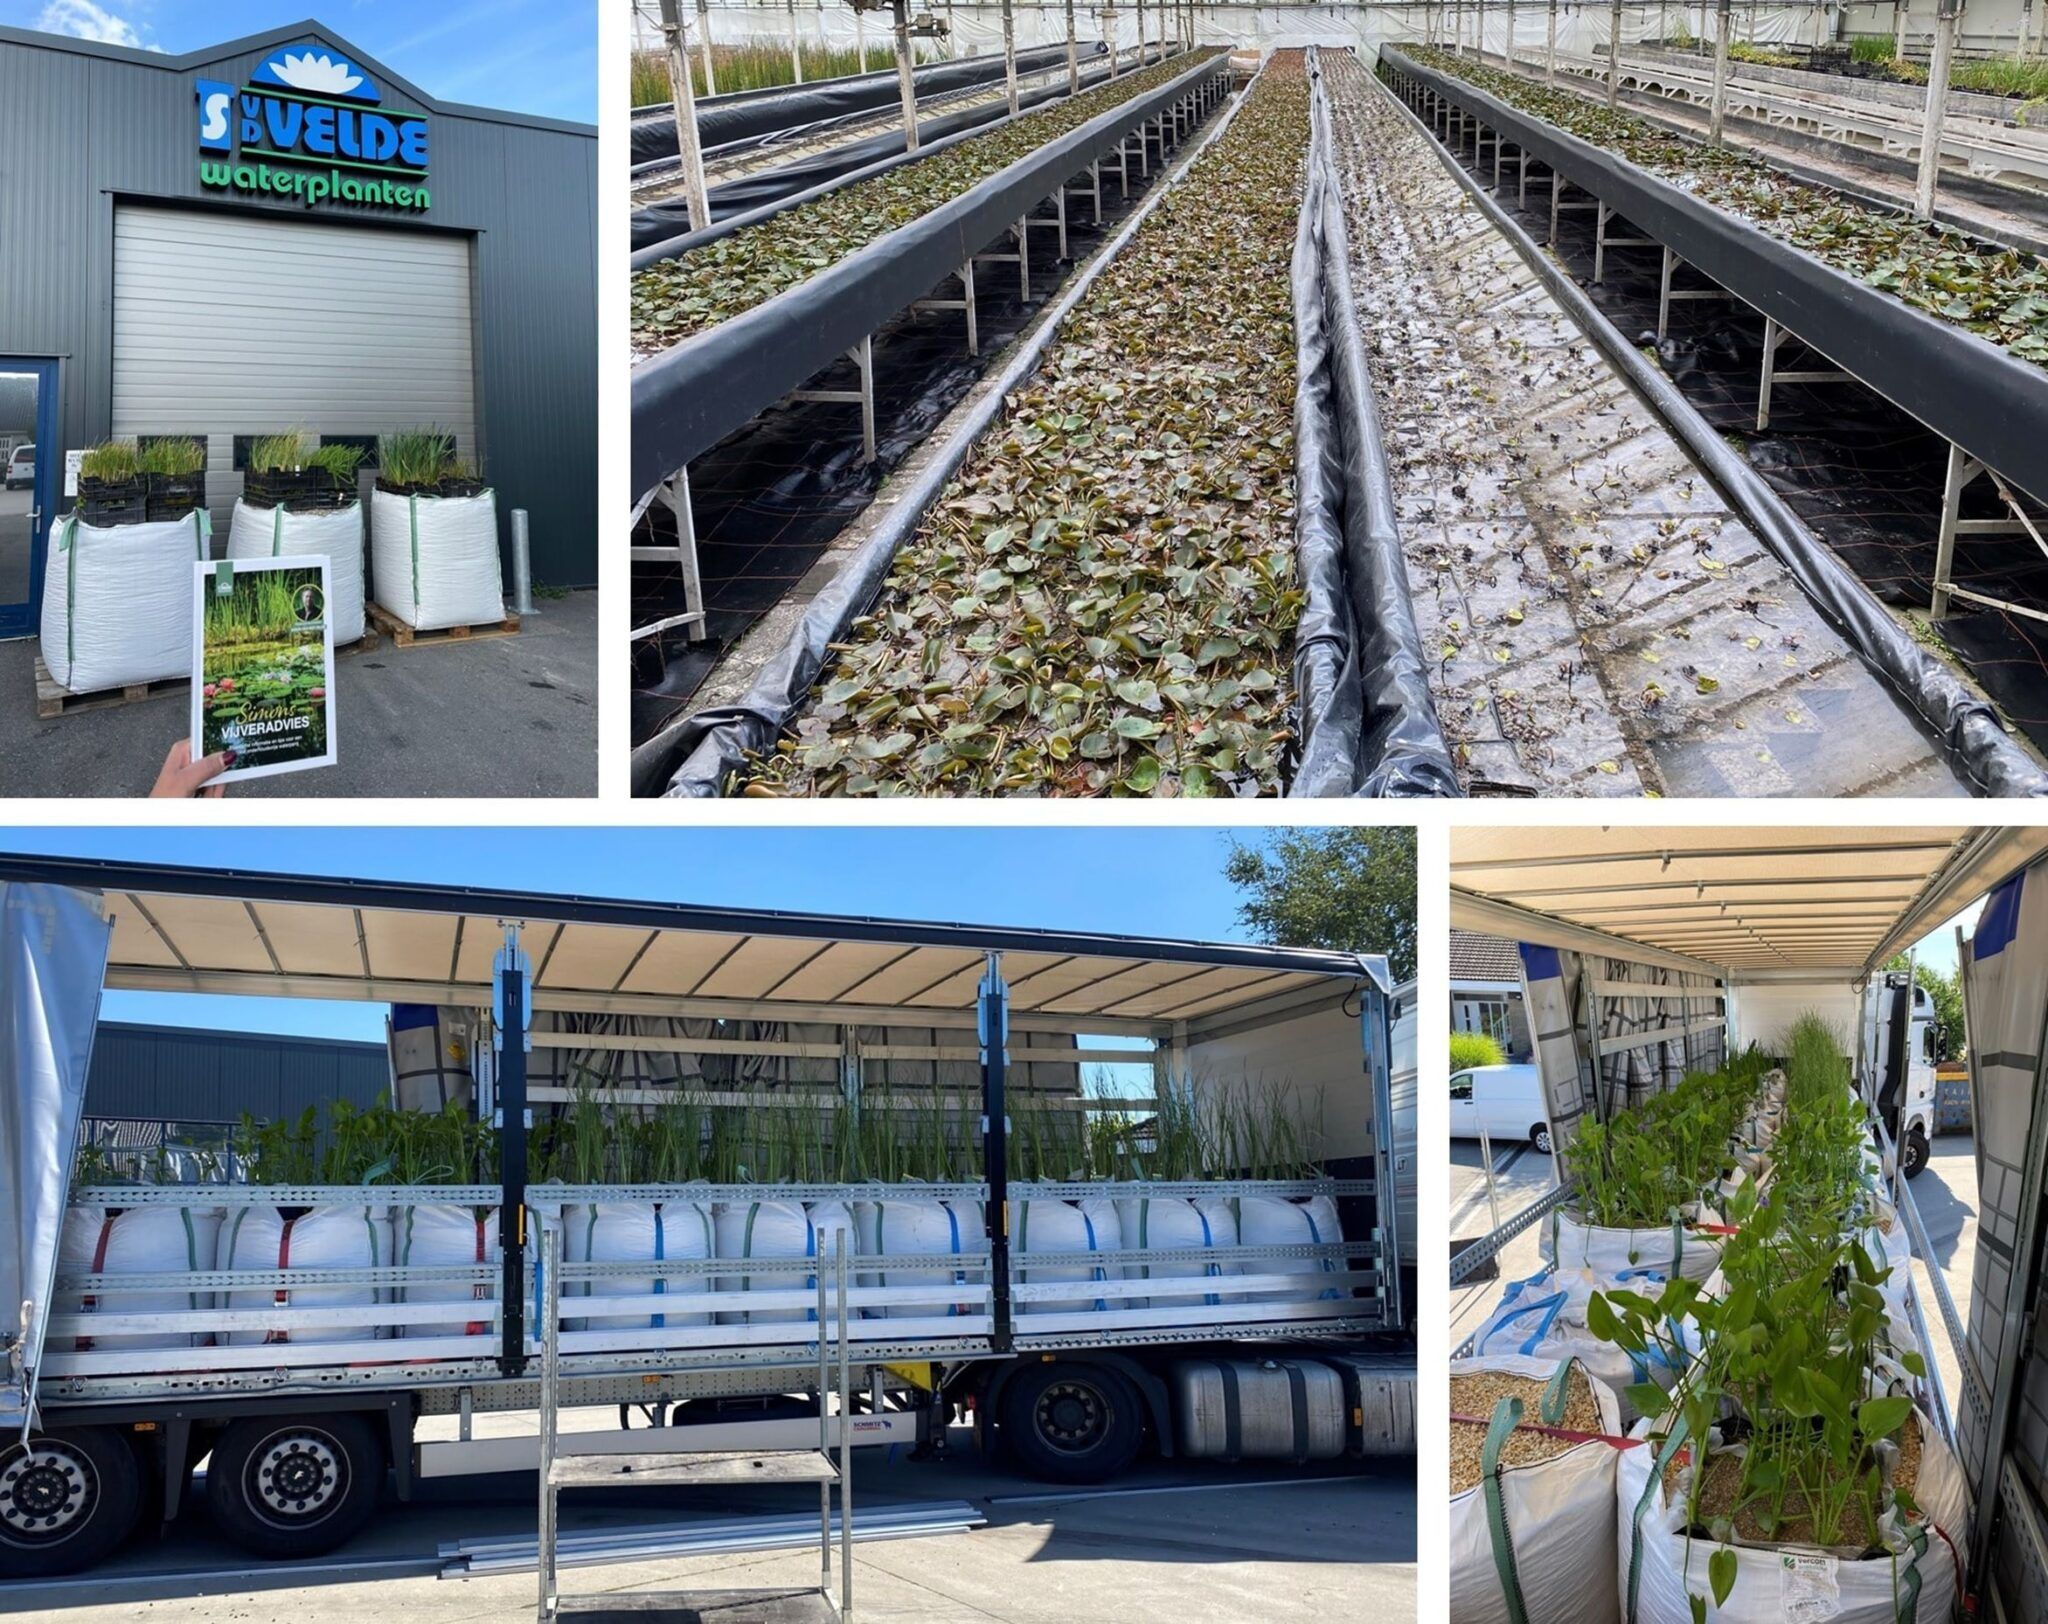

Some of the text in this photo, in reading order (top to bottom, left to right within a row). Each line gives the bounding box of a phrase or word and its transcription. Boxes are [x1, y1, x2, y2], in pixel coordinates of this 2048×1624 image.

[264, 98, 429, 167] VELDE
[200, 162, 431, 208] waterplanten
[221, 715, 310, 739] VIJVERADVIES
[235, 701, 297, 725] Simons
